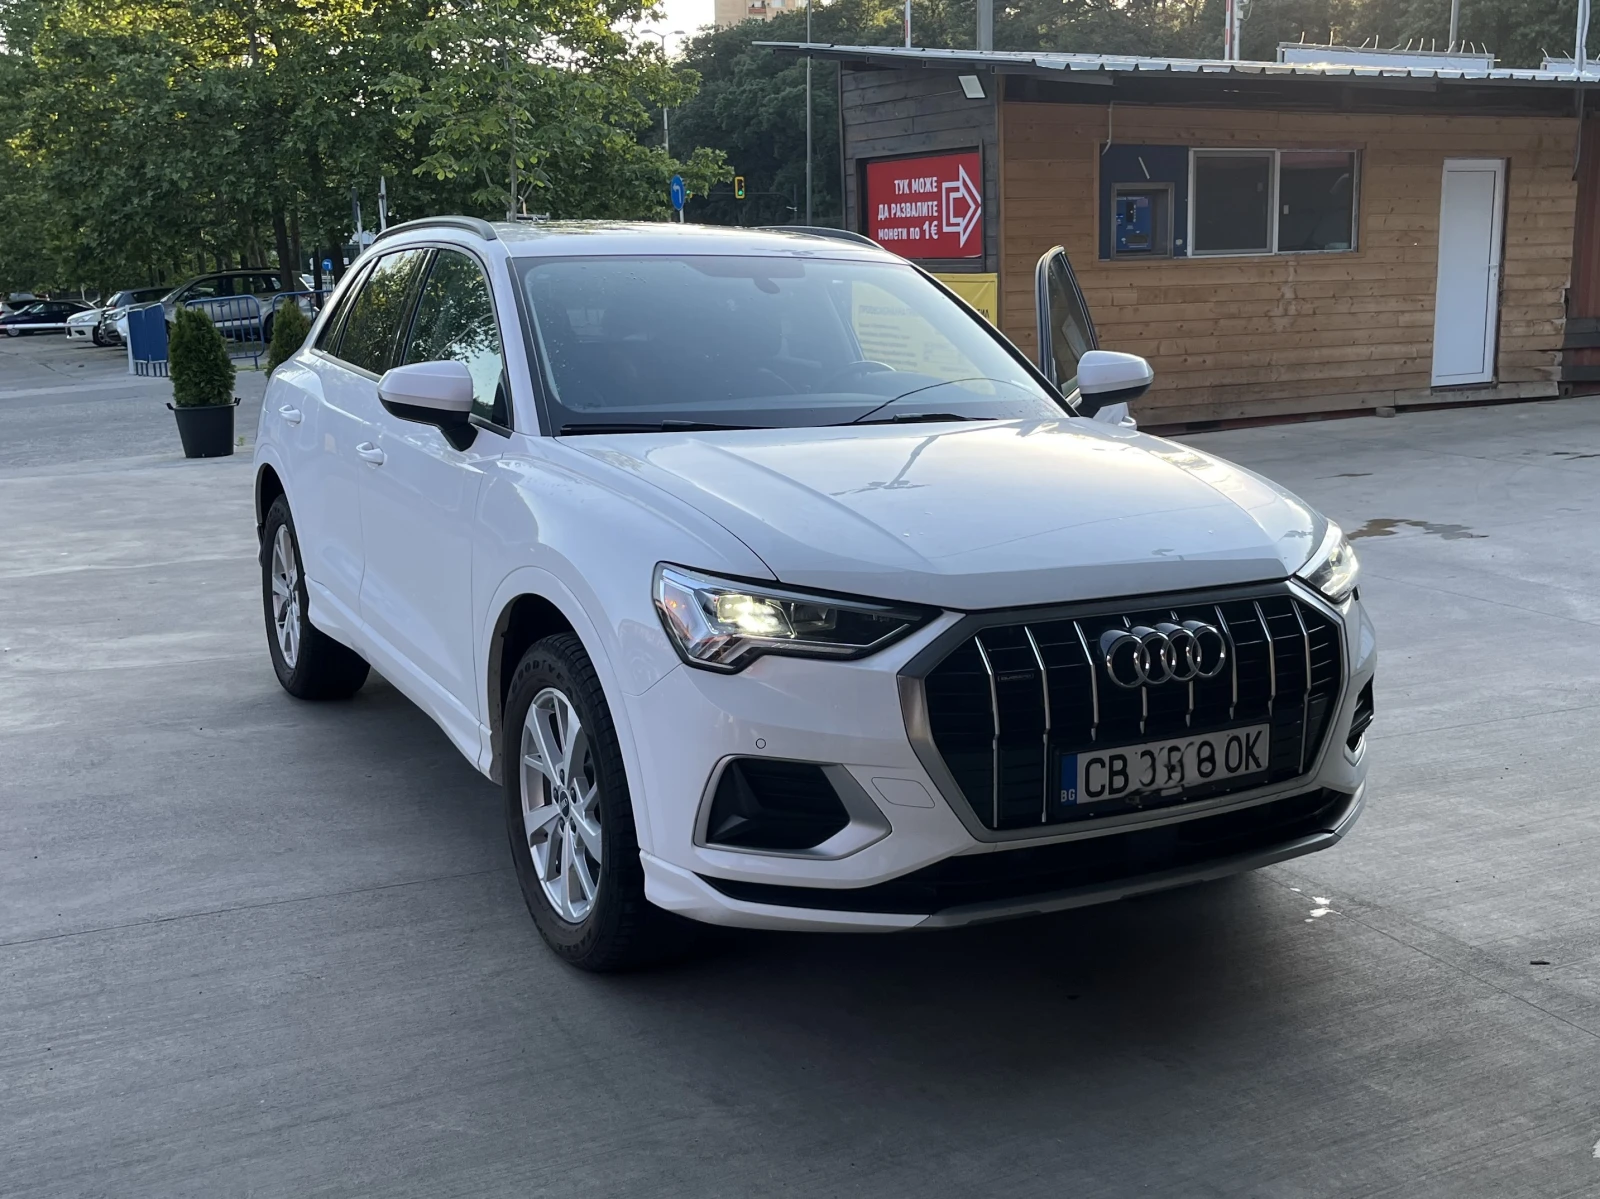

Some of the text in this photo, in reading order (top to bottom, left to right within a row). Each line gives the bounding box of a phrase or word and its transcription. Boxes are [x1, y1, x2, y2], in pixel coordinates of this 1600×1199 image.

[894, 177, 938, 195] ТУК МОЖЕ
[877, 201, 938, 221] ДА РАЗВАЛИТЕ
[878, 221, 939, 241] монети по 1€
[1084, 753, 1130, 798] CB
[1224, 730, 1263, 774] OK
[1060, 789, 1076, 802] BG
